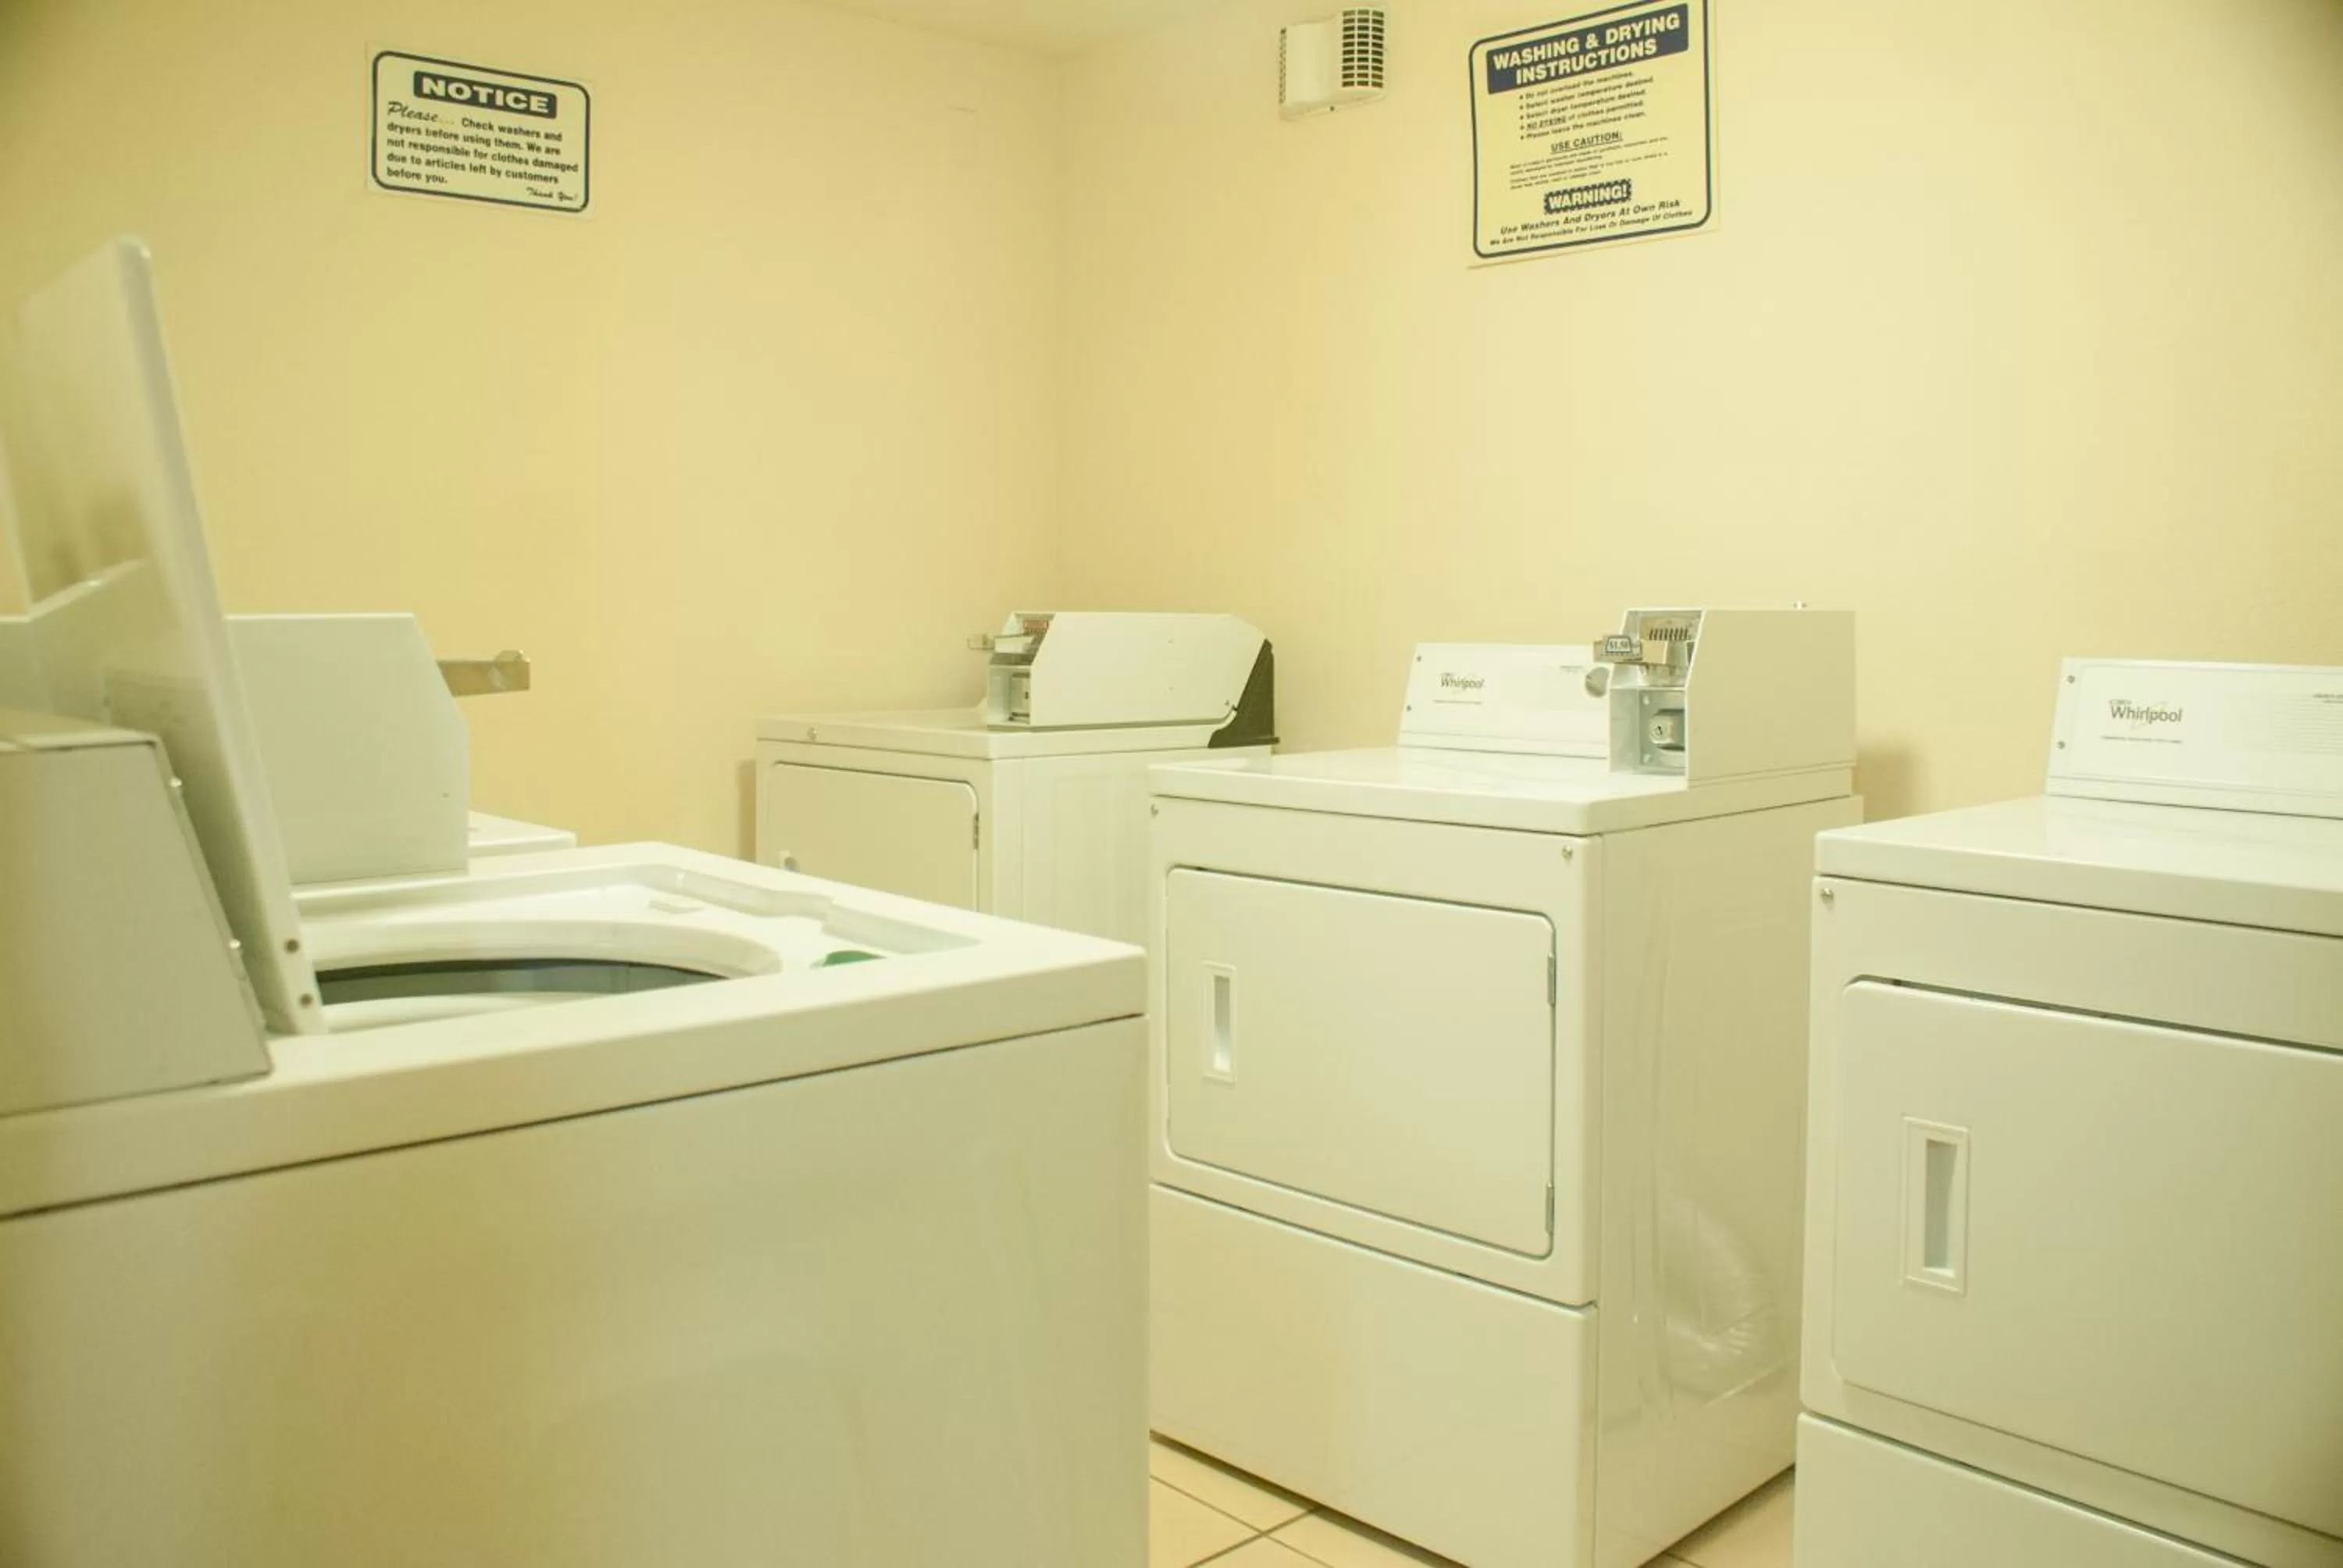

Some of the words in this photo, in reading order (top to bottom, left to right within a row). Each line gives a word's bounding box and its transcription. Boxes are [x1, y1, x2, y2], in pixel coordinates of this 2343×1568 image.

[1493, 37, 1580, 70] WASHING
[1585, 33, 1599, 49] &
[1605, 12, 1680, 45] DRYING
[1516, 37, 1657, 85] INSTRUCTIONS
[423, 77, 549, 113] NOTICE
[1570, 97, 1615, 109] temperature
[1578, 84, 1622, 98] temperature
[387, 122, 422, 135] dryers
[425, 128, 459, 140] before
[463, 134, 491, 148] using
[494, 137, 523, 150] them.
[526, 142, 542, 153] We
[544, 146, 561, 155] are
[462, 116, 494, 132] Check
[497, 125, 540, 139] washers
[544, 130, 563, 142] and
[1551, 141, 1569, 152] USE
[1573, 130, 1622, 148] CAUTION:
[387, 138, 405, 149] not
[408, 141, 470, 156] responsible
[474, 148, 488, 159] for
[491, 152, 529, 166] clothes
[532, 158, 579, 173] damaged
[387, 152, 407, 163] due
[410, 155, 422, 165] to
[425, 157, 466, 171] articles
[469, 162, 487, 175] left
[490, 166, 502, 179] by
[505, 169, 558, 184] customers
[387, 166, 422, 180] before
[425, 174, 448, 184] you.
[1549, 184, 1628, 210] WARNING!
[1500, 224, 1518, 235] Use
[1521, 219, 1560, 232] Washers
[1563, 215, 1582, 226] And
[1584, 210, 1616, 223] Dryers
[1619, 206, 1630, 217] At
[1633, 204, 1656, 215] Own
[1658, 198, 1681, 211] Risk
[1440, 675, 1485, 691] Whirlpool
[2109, 703, 2183, 722] Whirlpool
